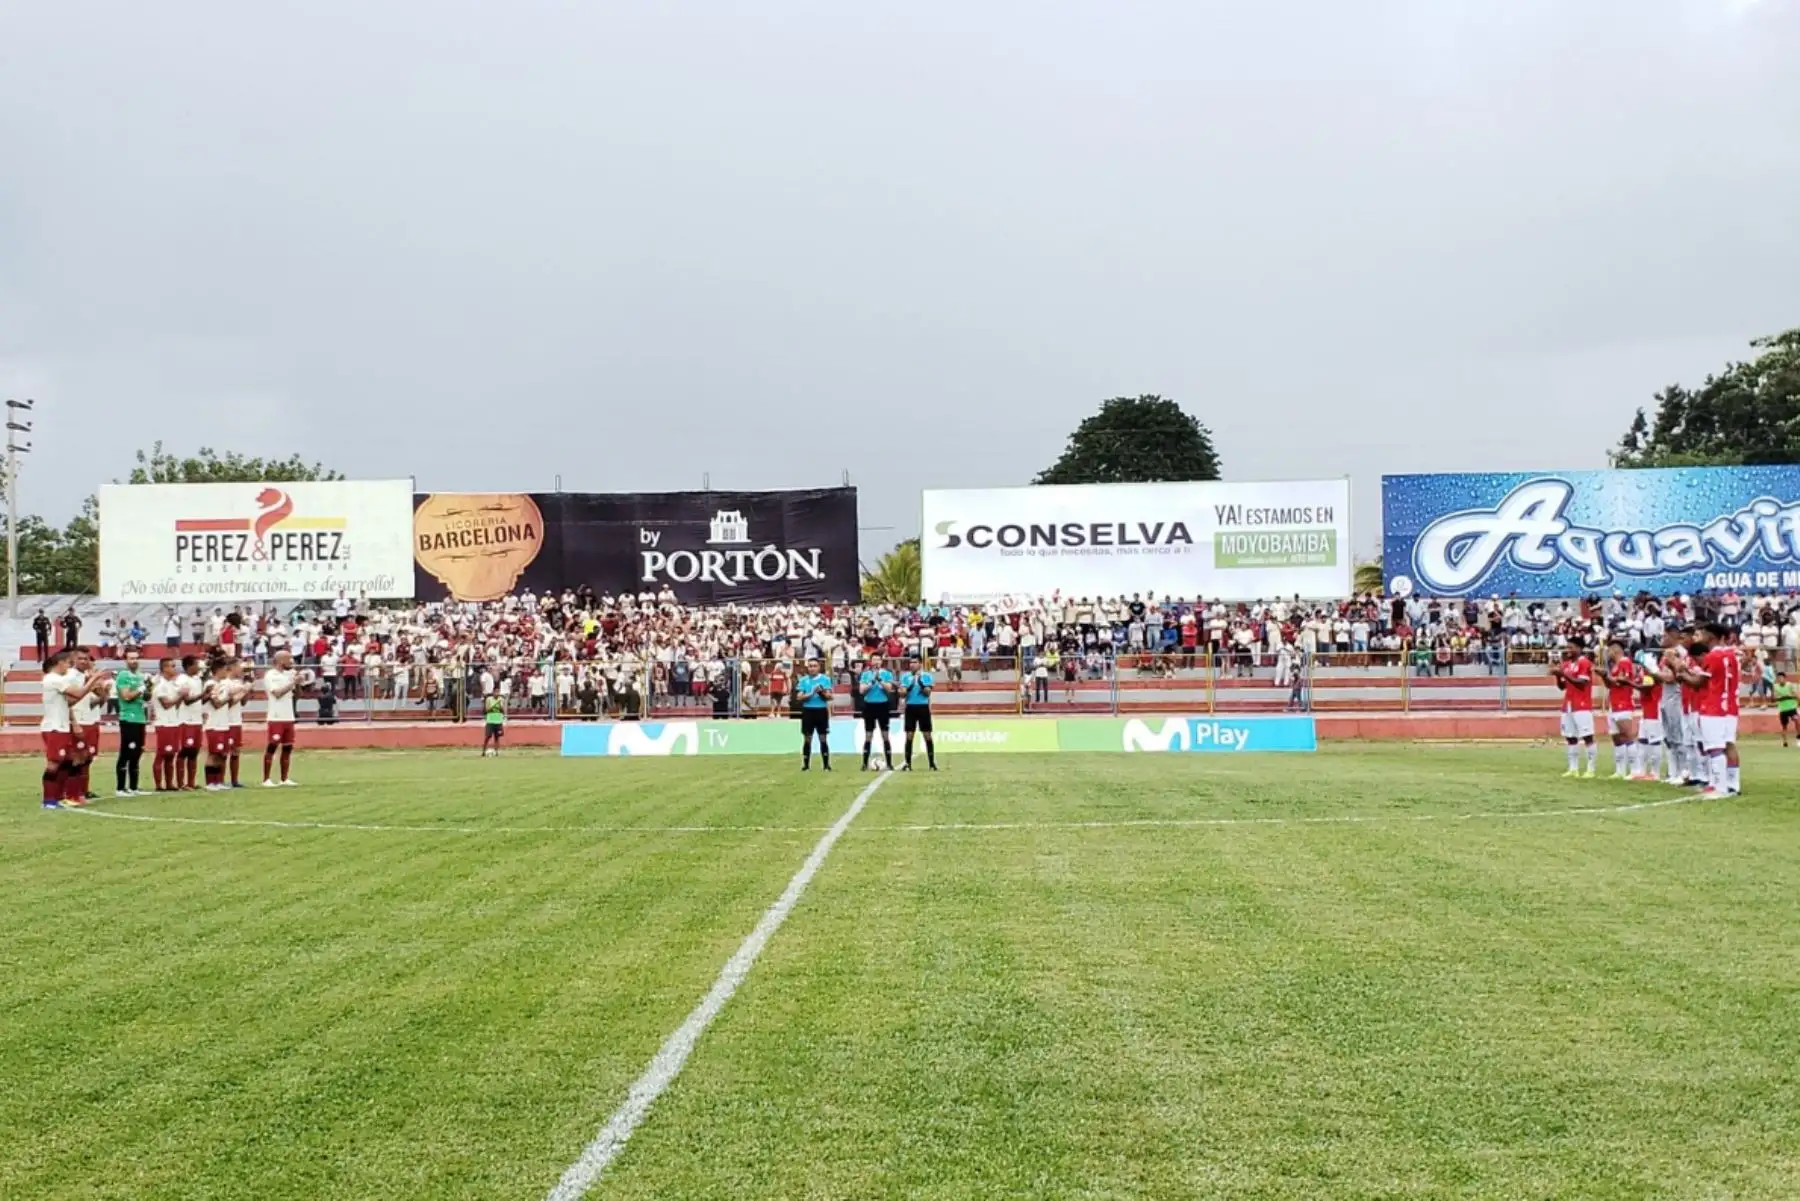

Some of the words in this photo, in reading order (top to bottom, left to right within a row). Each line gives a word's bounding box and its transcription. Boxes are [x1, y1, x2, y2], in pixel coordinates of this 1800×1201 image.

[1214, 504, 1242, 526] YA!
[1246, 508, 1313, 525] ESTAMOS
[1316, 506, 1334, 523] EN
[419, 523, 537, 551] BARCELONA
[640, 528, 661, 547] by
[1222, 532, 1330, 554] MOYOBAMBA
[641, 544, 826, 587] PORTÓN.
[181, 582, 194, 594] es
[303, 580, 317, 593] es
[1704, 571, 1752, 588] AGUA
[1756, 571, 1779, 588] DE
[704, 729, 729, 748] Tv
[1196, 722, 1249, 750] Play
